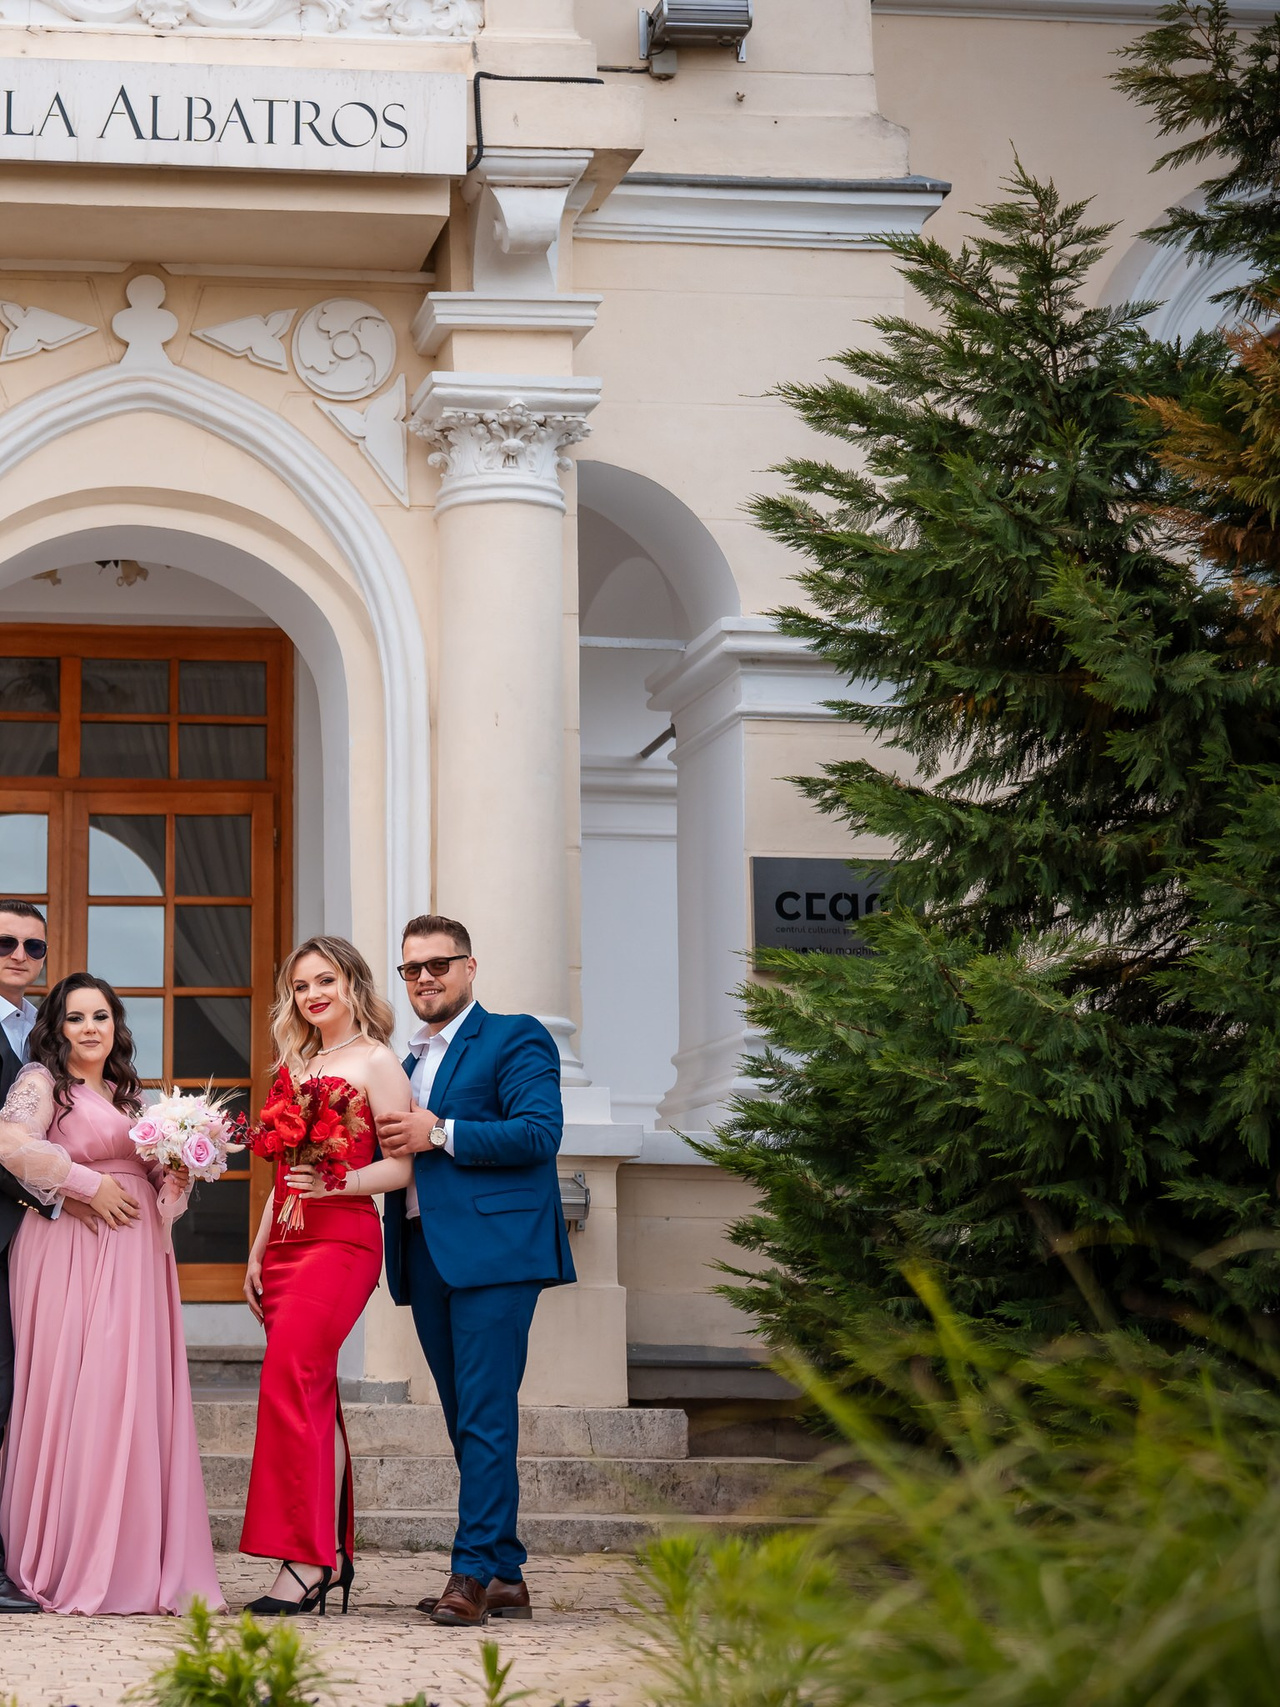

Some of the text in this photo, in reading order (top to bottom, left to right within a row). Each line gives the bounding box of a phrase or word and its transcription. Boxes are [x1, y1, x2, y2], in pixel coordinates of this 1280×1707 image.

[96, 84, 408, 149] ALBATROS
[776, 926, 806, 934] centrul
[808, 926, 841, 935] cultural
